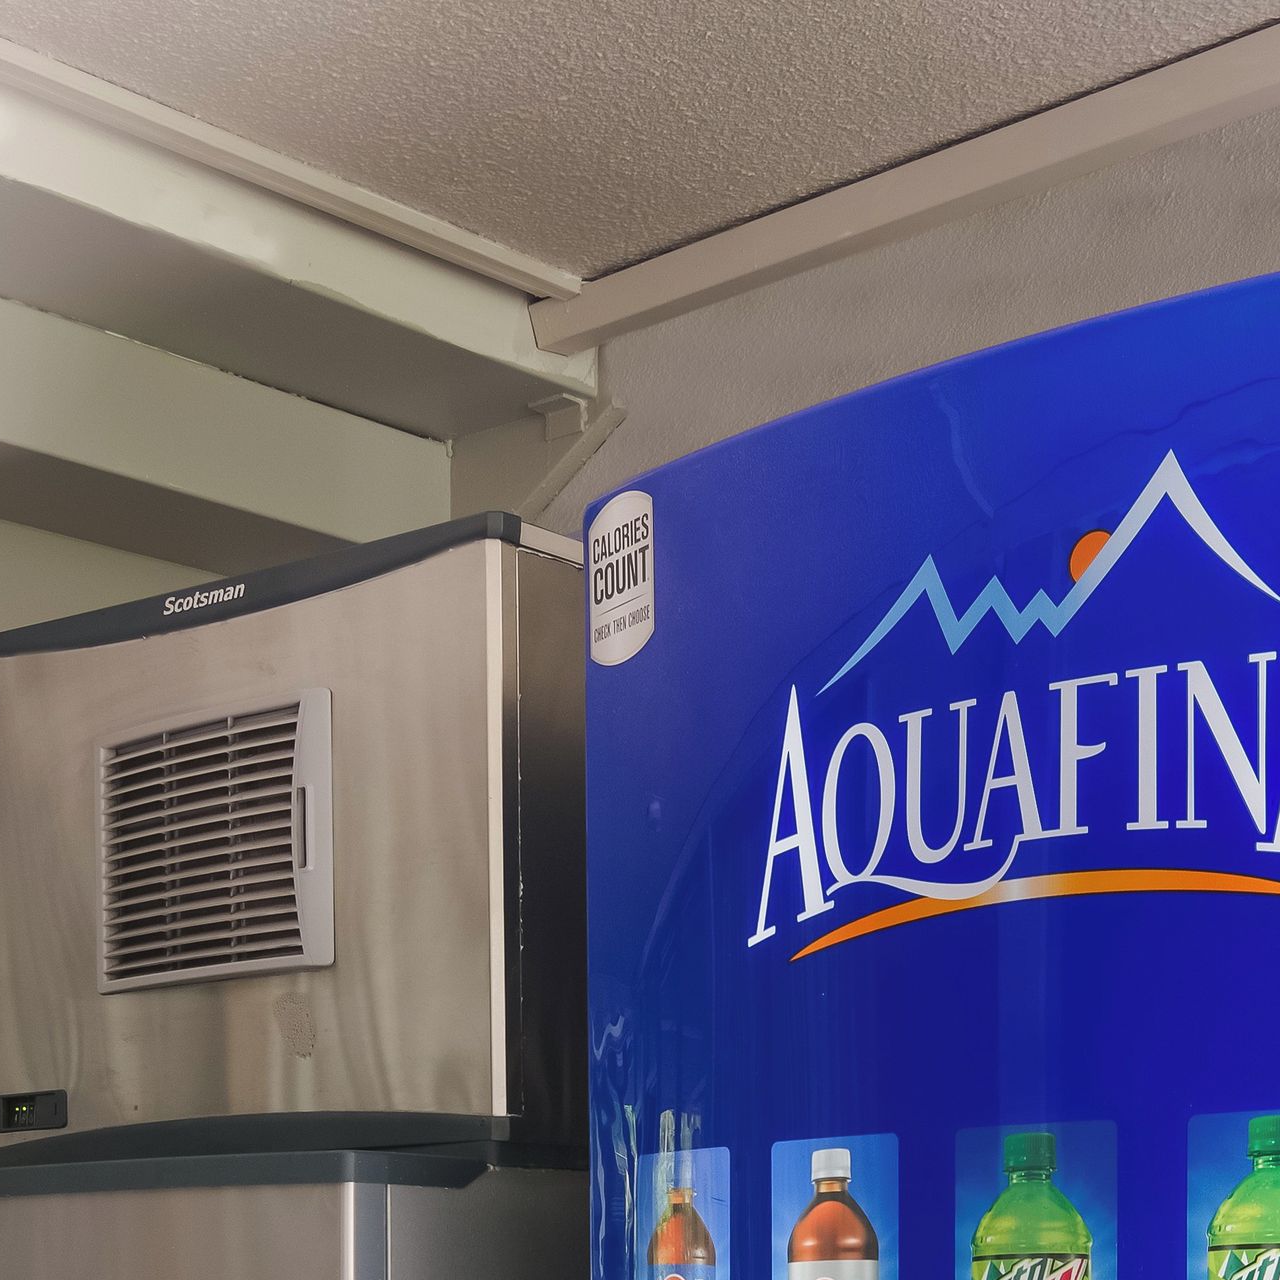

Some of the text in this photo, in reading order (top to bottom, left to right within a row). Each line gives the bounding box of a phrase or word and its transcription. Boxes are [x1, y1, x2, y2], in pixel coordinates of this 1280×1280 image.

[592, 512, 649, 565] CALORIES
[593, 543, 650, 606] COUNT
[163, 583, 245, 616] Scotsman
[593, 604, 651, 644] CHECK THEN CHOOSE
